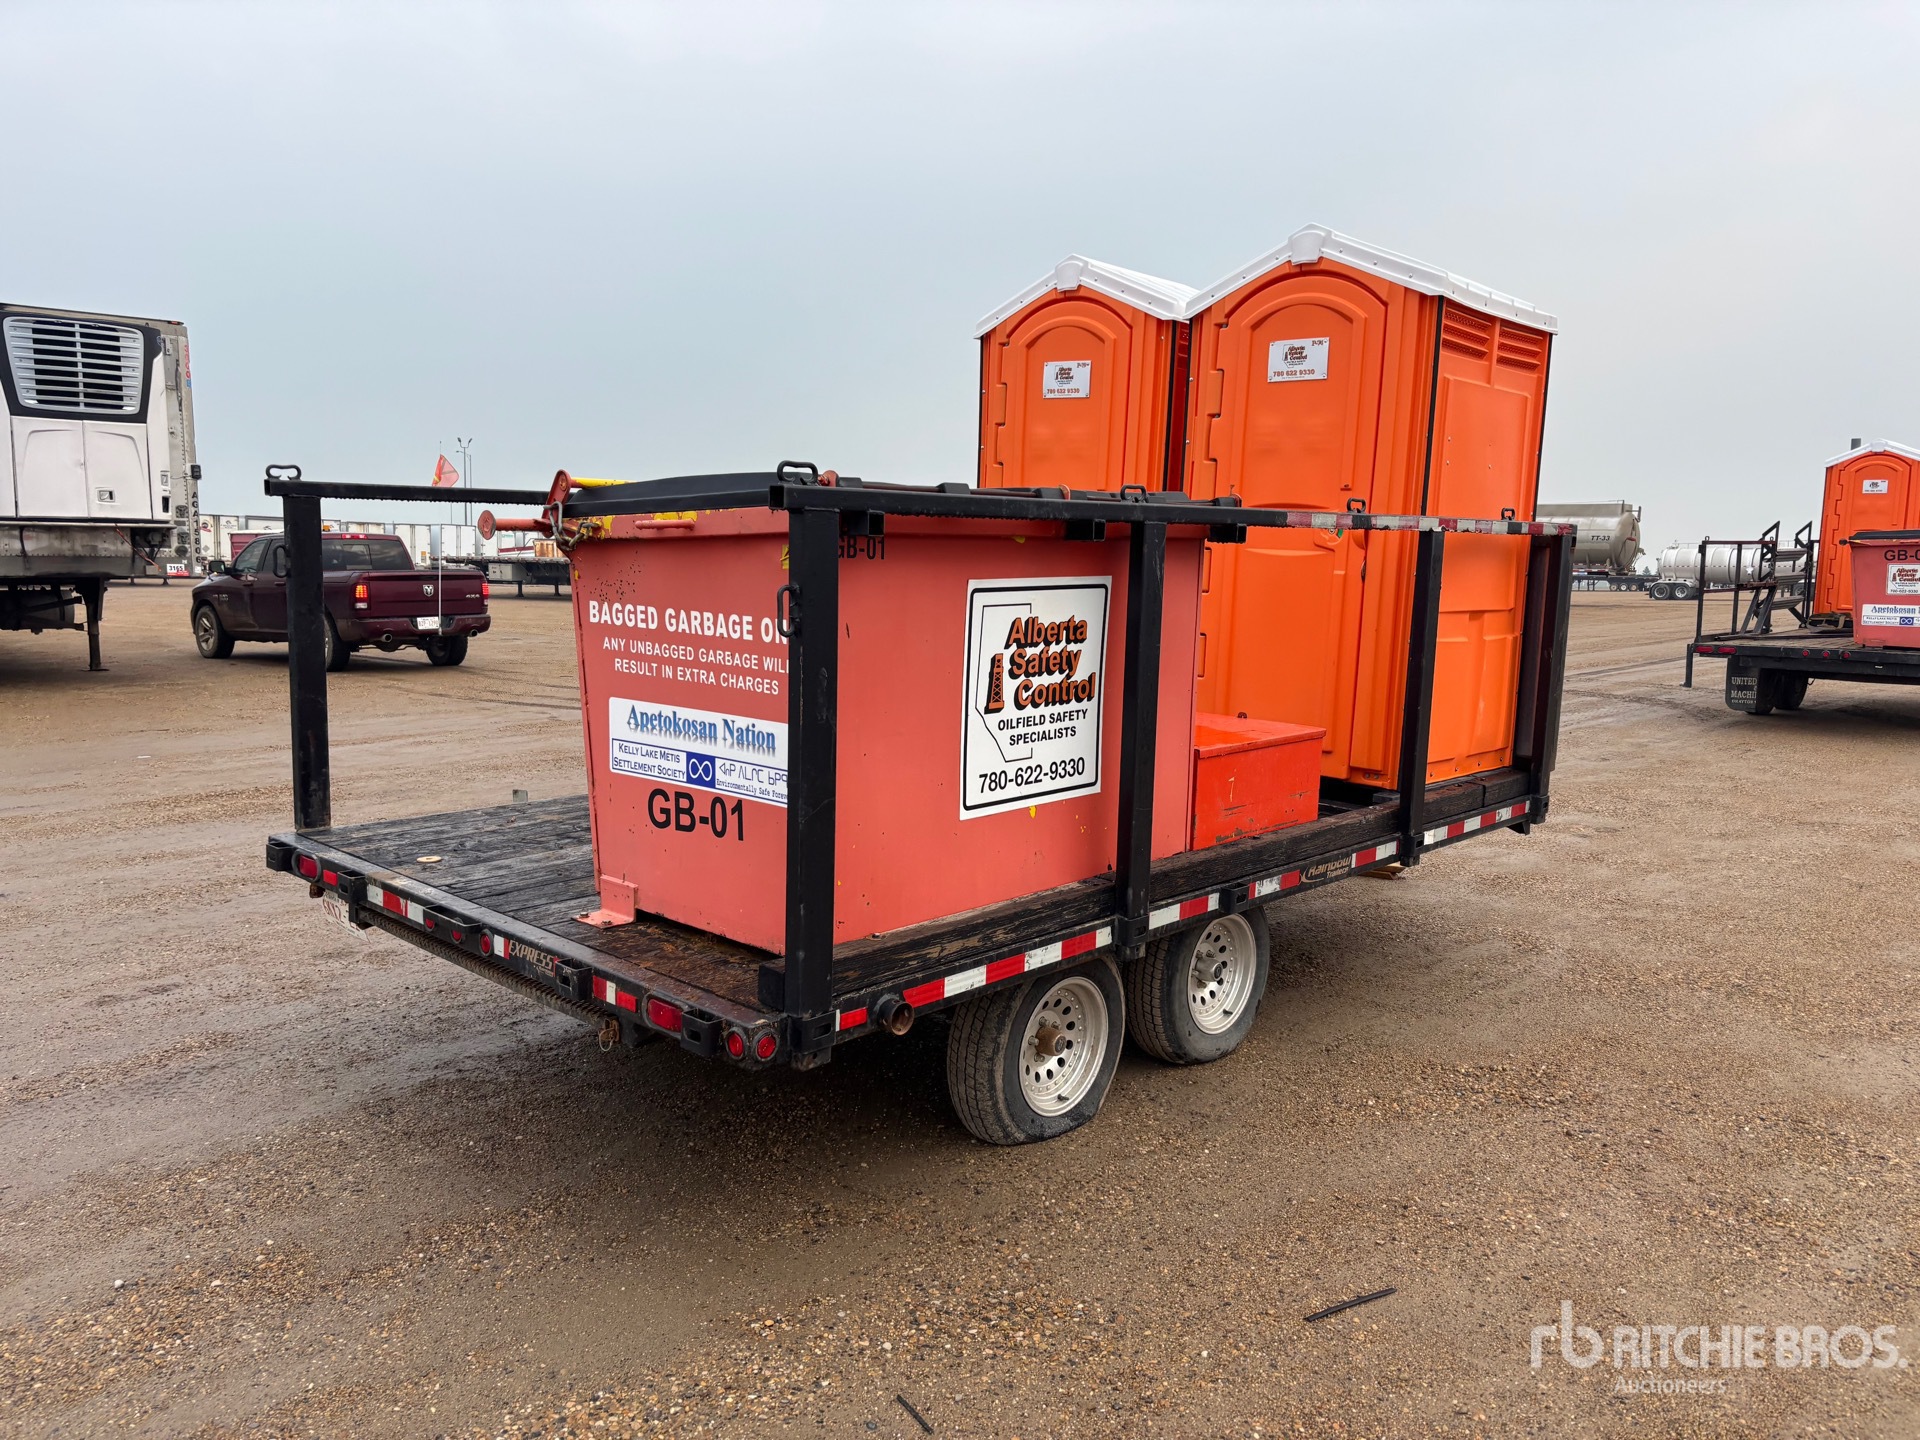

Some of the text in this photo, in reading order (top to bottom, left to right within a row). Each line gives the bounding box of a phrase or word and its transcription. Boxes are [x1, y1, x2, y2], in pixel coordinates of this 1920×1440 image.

[589, 600, 658, 630] BAGGED
[665, 608, 753, 641] GARBAGE
[1005, 615, 1088, 649] Alberta
[603, 637, 626, 652] ANY
[629, 640, 694, 661] UNBAGGED
[699, 648, 758, 670] GARBAGE
[1008, 645, 1082, 680] Safety
[615, 658, 779, 695] RESULT IN EXTRA CHARGES
[1014, 672, 1096, 710] Control
[1731, 676, 1758, 685] UNITED
[627, 704, 776, 750] Apetokosan Nation
[997, 708, 1088, 731] OILFIELD SAFETY
[1009, 726, 1077, 746] SPECIALISTS
[618, 742, 640, 756] KELLY
[640, 746, 659, 760] LAKE
[613, 756, 686, 780] SETTLEMENT SOCIETY
[979, 756, 1085, 794] 780-622-9330
[716, 778, 757, 796] Environmentally
[759, 787, 770, 797] Safe
[647, 788, 744, 841] GB-01
[509, 940, 554, 970] EXPRESS
